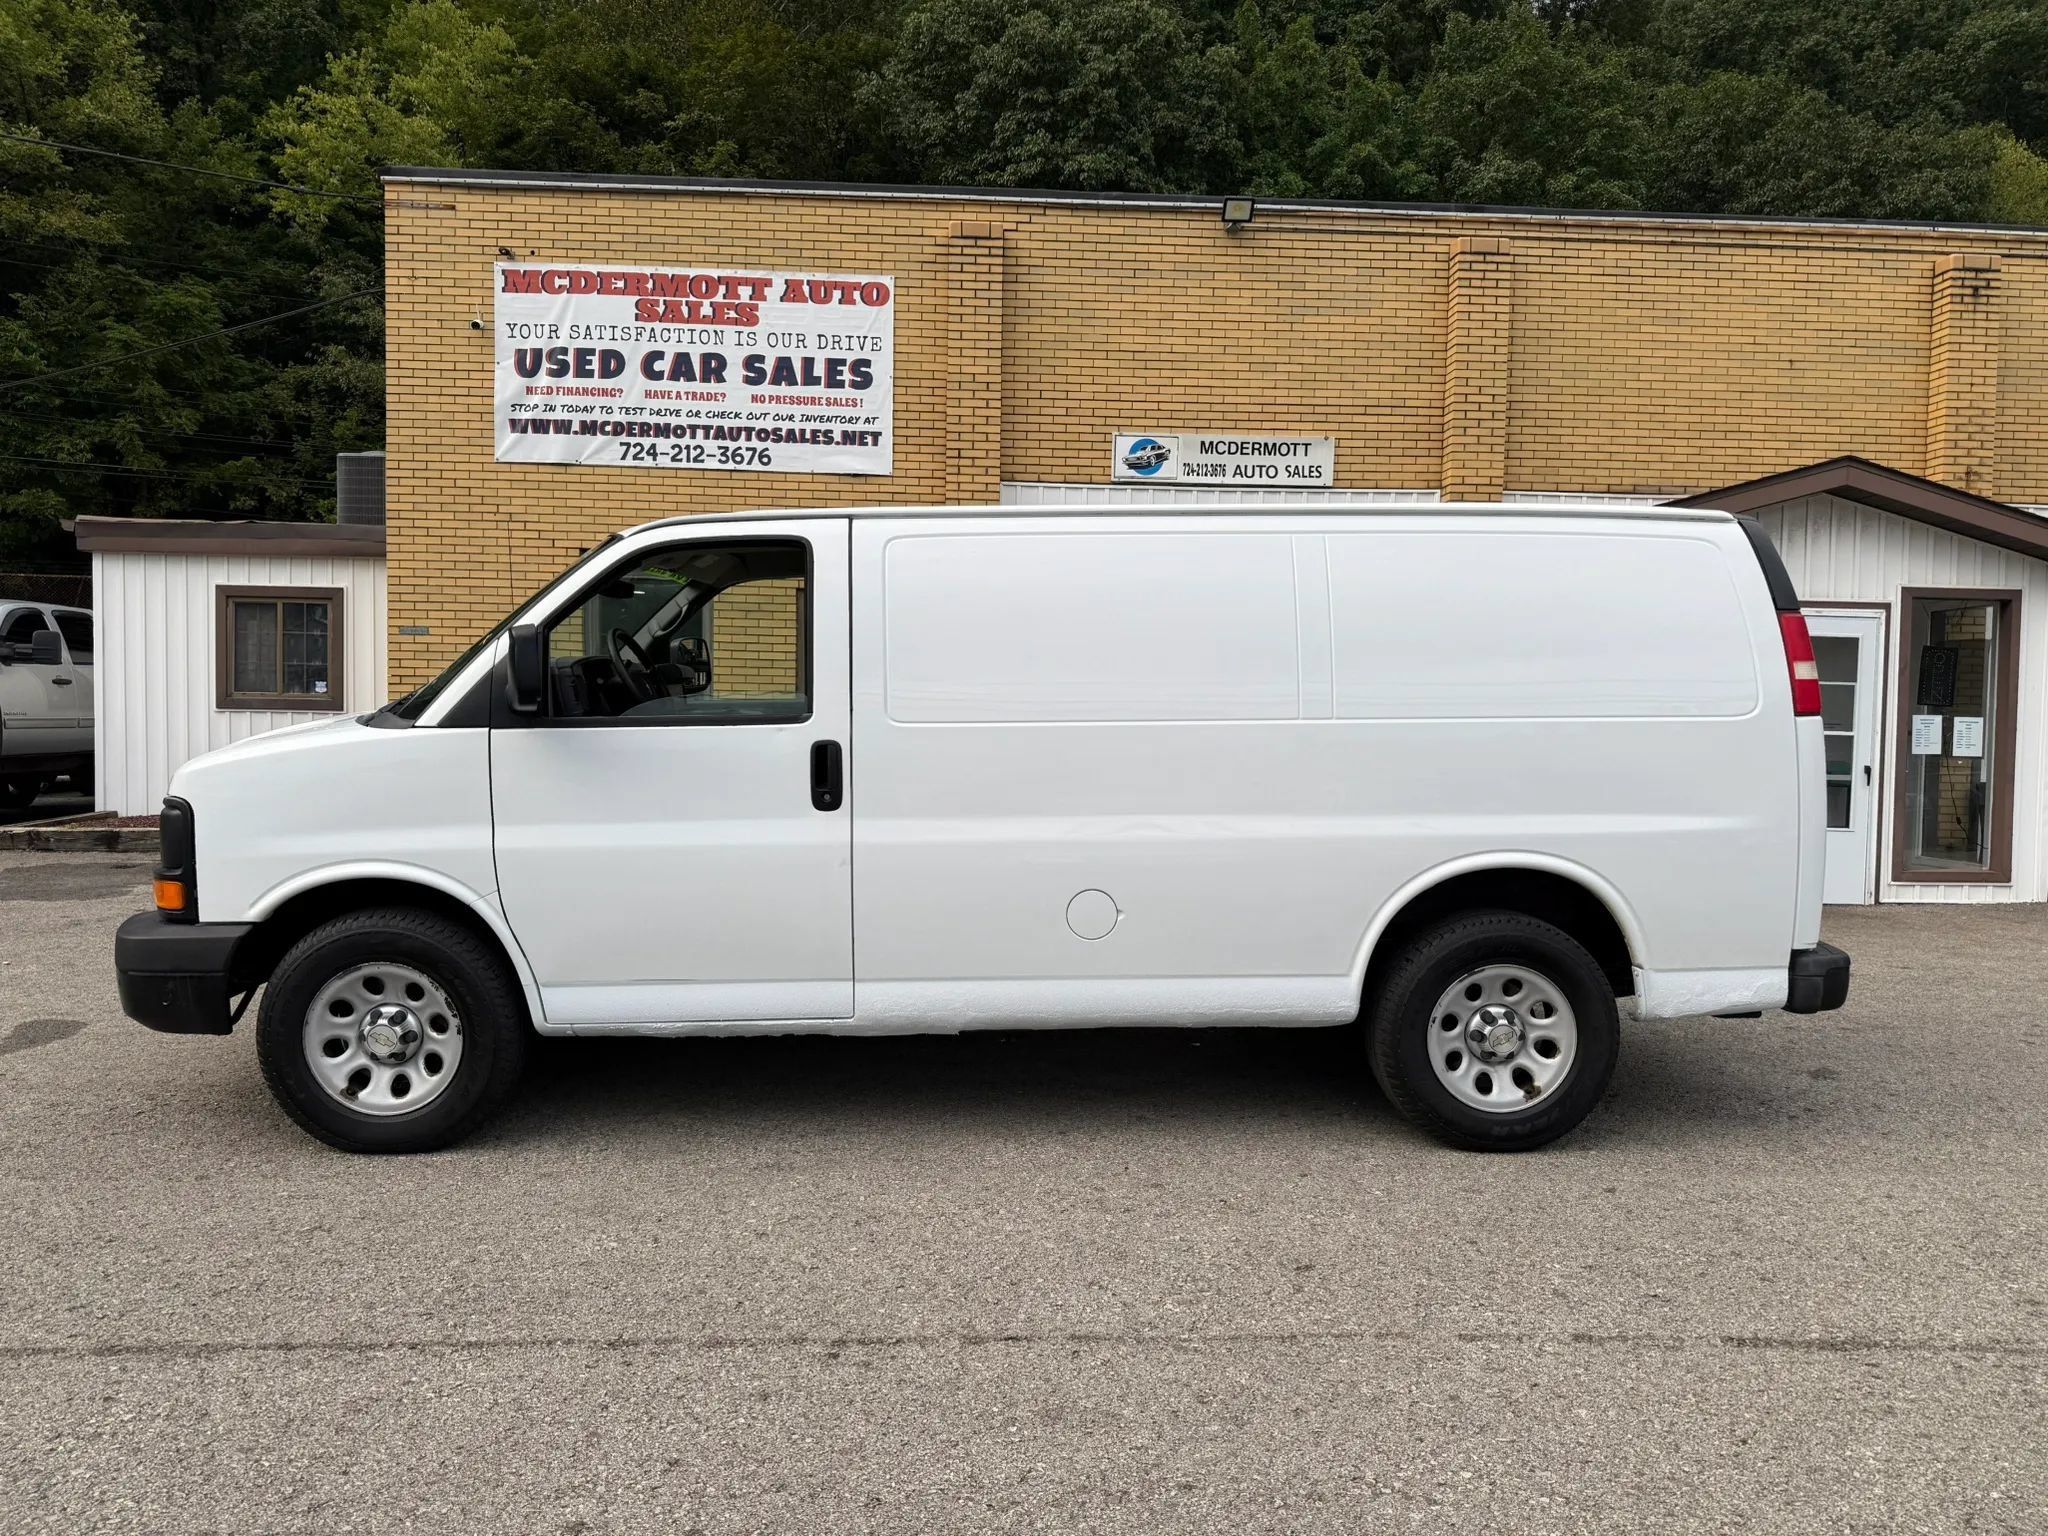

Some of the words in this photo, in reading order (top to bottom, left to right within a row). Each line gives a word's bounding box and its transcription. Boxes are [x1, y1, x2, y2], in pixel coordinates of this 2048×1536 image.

[502, 269, 773, 301] MCDERMOTT
[780, 279, 891, 307] AUTO
[634, 298, 760, 327] SALES
[506, 323, 560, 339] YOUR
[569, 325, 724, 345] SATISFACTION
[734, 331, 758, 346] IS
[767, 333, 808, 348] OUR
[817, 334, 882, 352] DRIVE
[514, 346, 626, 379] USED
[640, 350, 728, 384] CAR
[742, 354, 873, 391] SALES
[525, 386, 554, 396] NEED
[556, 387, 624, 398] FINANCING?
[644, 389, 673, 400] HAVE
[674, 390, 683, 401] A
[684, 391, 727, 403] TRADE?
[750, 393, 766, 404] NO
[768, 395, 824, 406] PRESSURE
[510, 404, 539, 413] STOP
[543, 404, 556, 413] IN
[560, 404, 596, 414] TODAY
[599, 406, 614, 415] TO
[618, 406, 647, 416] TEST
[649, 408, 683, 418] DRIVE
[686, 409, 702, 418] OR
[705, 410, 743, 420] CHECK
[746, 411, 770, 421] OUT
[772, 413, 796, 423] OUR
[799, 414, 861, 424] INVENTORY
[863, 416, 880, 425] AT
[508, 418, 882, 447] WWW.MCDERMOTTAUTOSALES.NET
[619, 442, 772, 466] 724-212-3676
[1200, 440, 1312, 457] MCDERMOTT
[1182, 462, 1227, 478] 724-212-3676
[1231, 464, 1279, 479] AUTO
[1284, 465, 1322, 479] SALES
